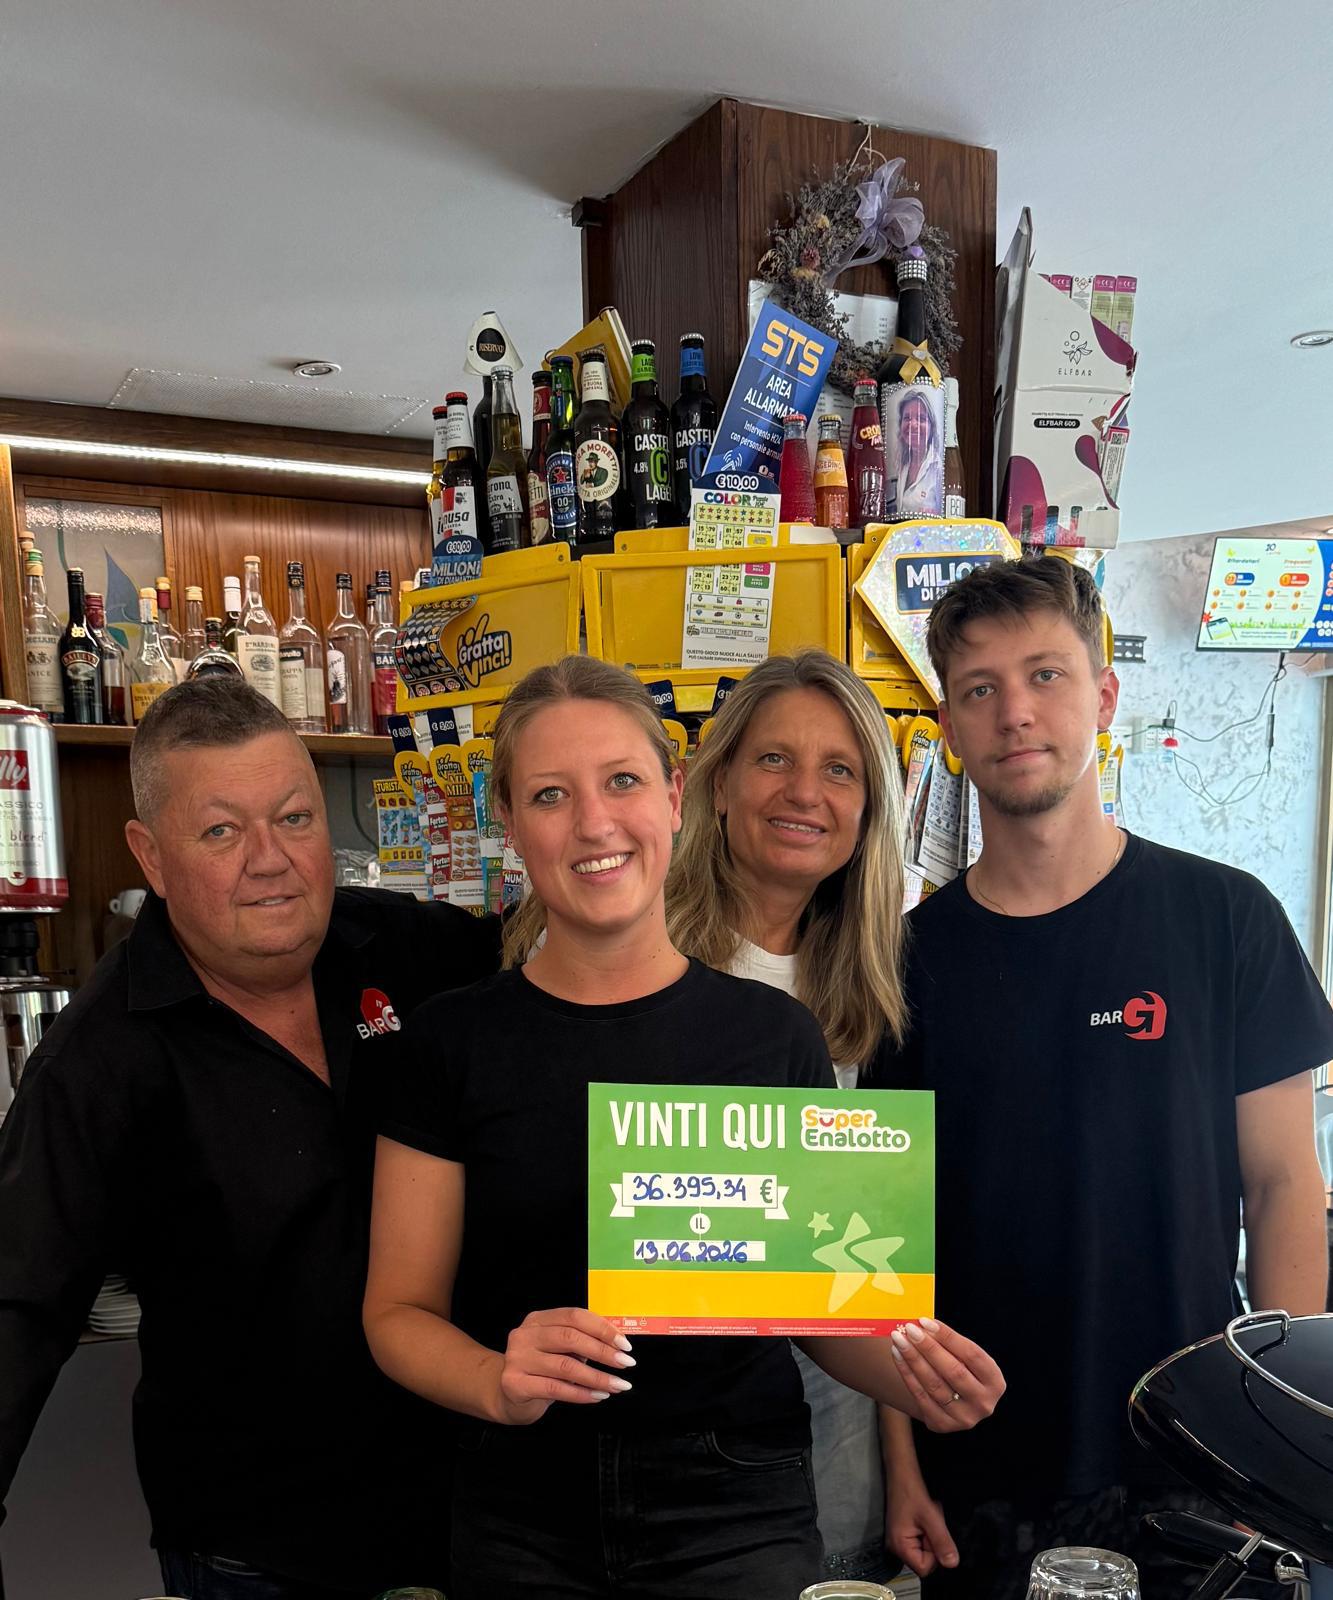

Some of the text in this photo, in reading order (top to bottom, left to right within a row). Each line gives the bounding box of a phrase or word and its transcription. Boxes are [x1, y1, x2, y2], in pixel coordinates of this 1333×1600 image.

[762, 319, 825, 377] STS
[1058, 368, 1092, 376] ELFBAR
[766, 374, 793, 399] AREA
[744, 421, 771, 441] Intervento
[730, 431, 740, 443] con
[739, 435, 768, 454] personale
[587, 443, 619, 472] MORETTI
[634, 462, 649, 474] 4.8%
[726, 475, 759, 491] 10,00
[704, 492, 752, 506] COLOR
[432, 560, 481, 577] MILIONI
[921, 587, 934, 601] DI
[459, 634, 503, 664] Gratta
[1089, 1010, 1123, 1027] BAR
[609, 1100, 786, 1151] VINTI QUI
[805, 1109, 873, 1131] Super
[805, 1128, 907, 1148] Enalotto
[632, 1174, 774, 1203] 36.395,34 €
[694, 1217, 706, 1231] IL
